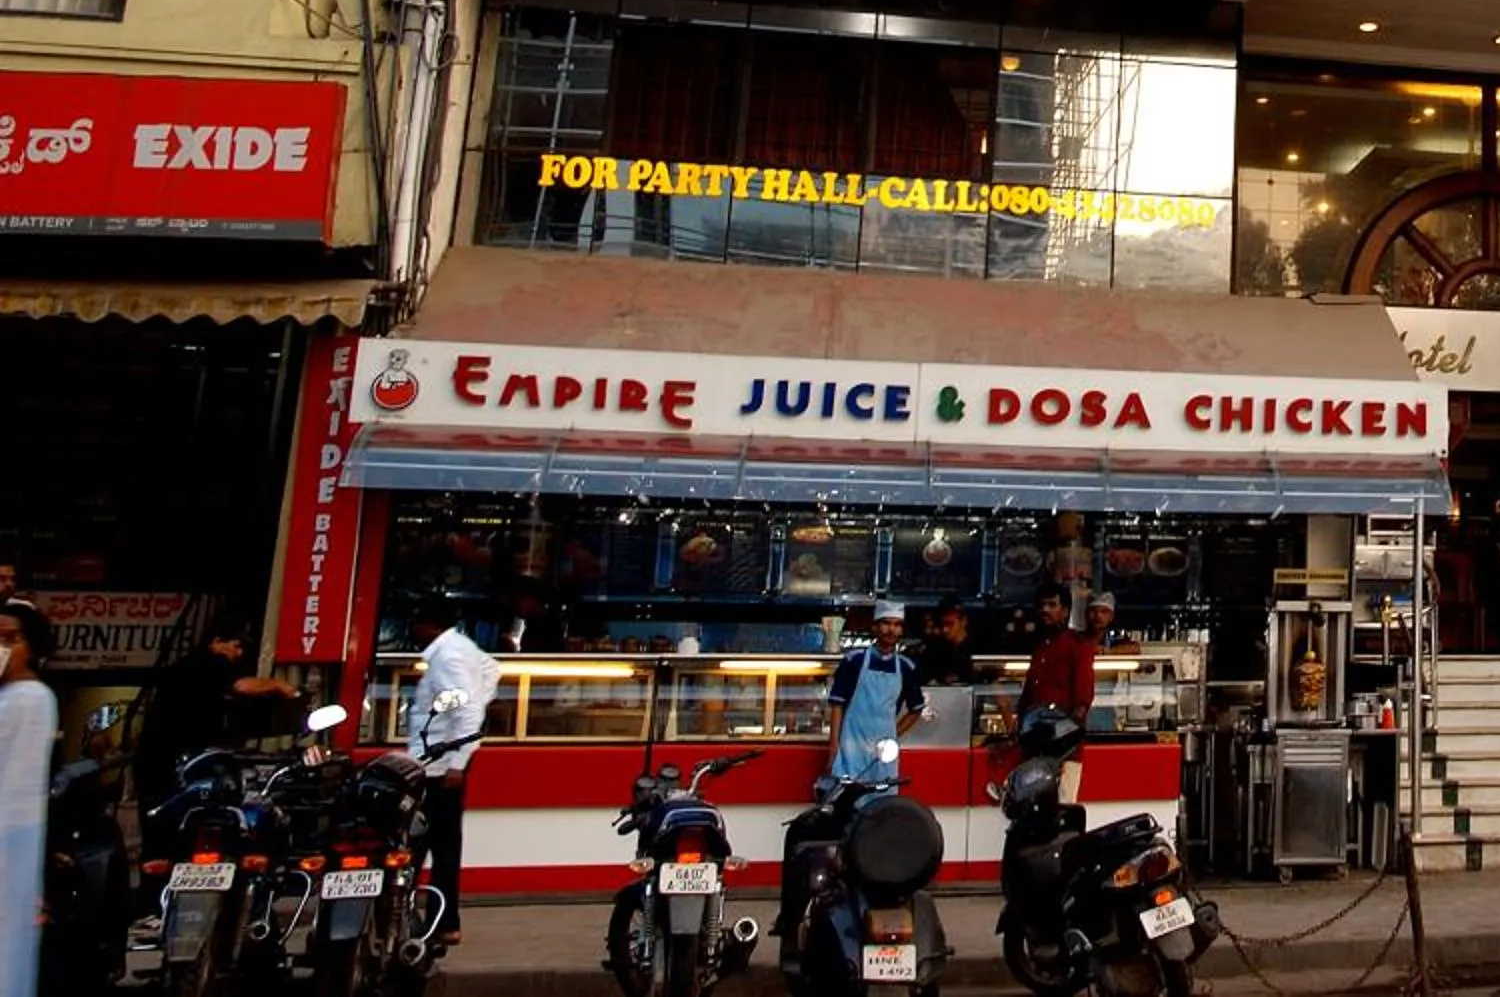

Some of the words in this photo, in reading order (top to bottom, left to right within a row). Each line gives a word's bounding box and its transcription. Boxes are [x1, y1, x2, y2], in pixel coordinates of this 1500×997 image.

[132, 123, 311, 172] EXIDE
[538, 153, 620, 191] FOR
[627, 158, 757, 201] PARTY
[9, 215, 75, 229] BATTERY
[1399, 330, 1476, 375] otel
[452, 355, 697, 429] EMPIRE
[739, 378, 912, 422] JUICE
[935, 385, 967, 423] &
[987, 388, 1152, 430] DOSA
[1184, 394, 1428, 438] CHICKEN
[301, 513, 332, 655] BATTERY
